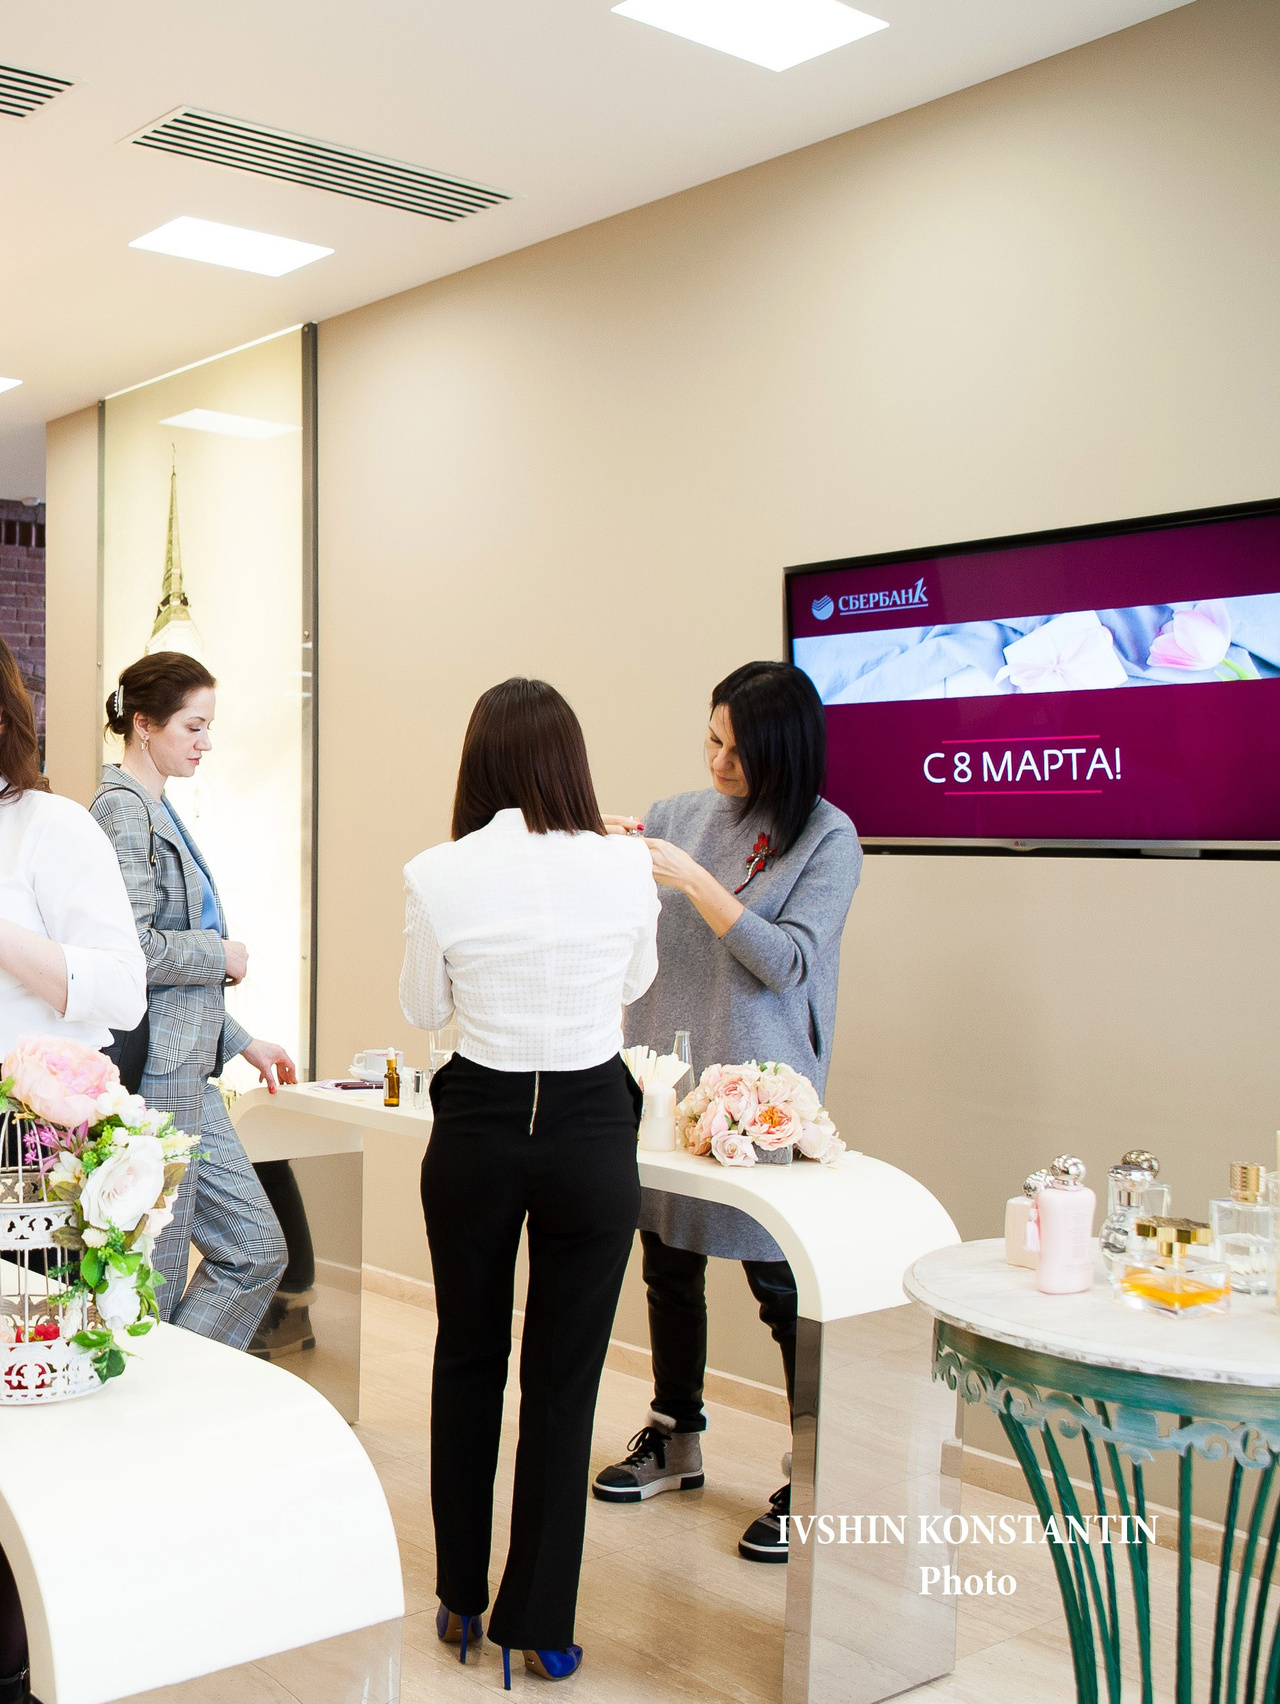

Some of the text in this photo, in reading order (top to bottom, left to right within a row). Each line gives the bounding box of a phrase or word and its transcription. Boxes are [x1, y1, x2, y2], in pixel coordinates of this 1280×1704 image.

[923, 747, 1121, 784] С 8 МАРТА!
